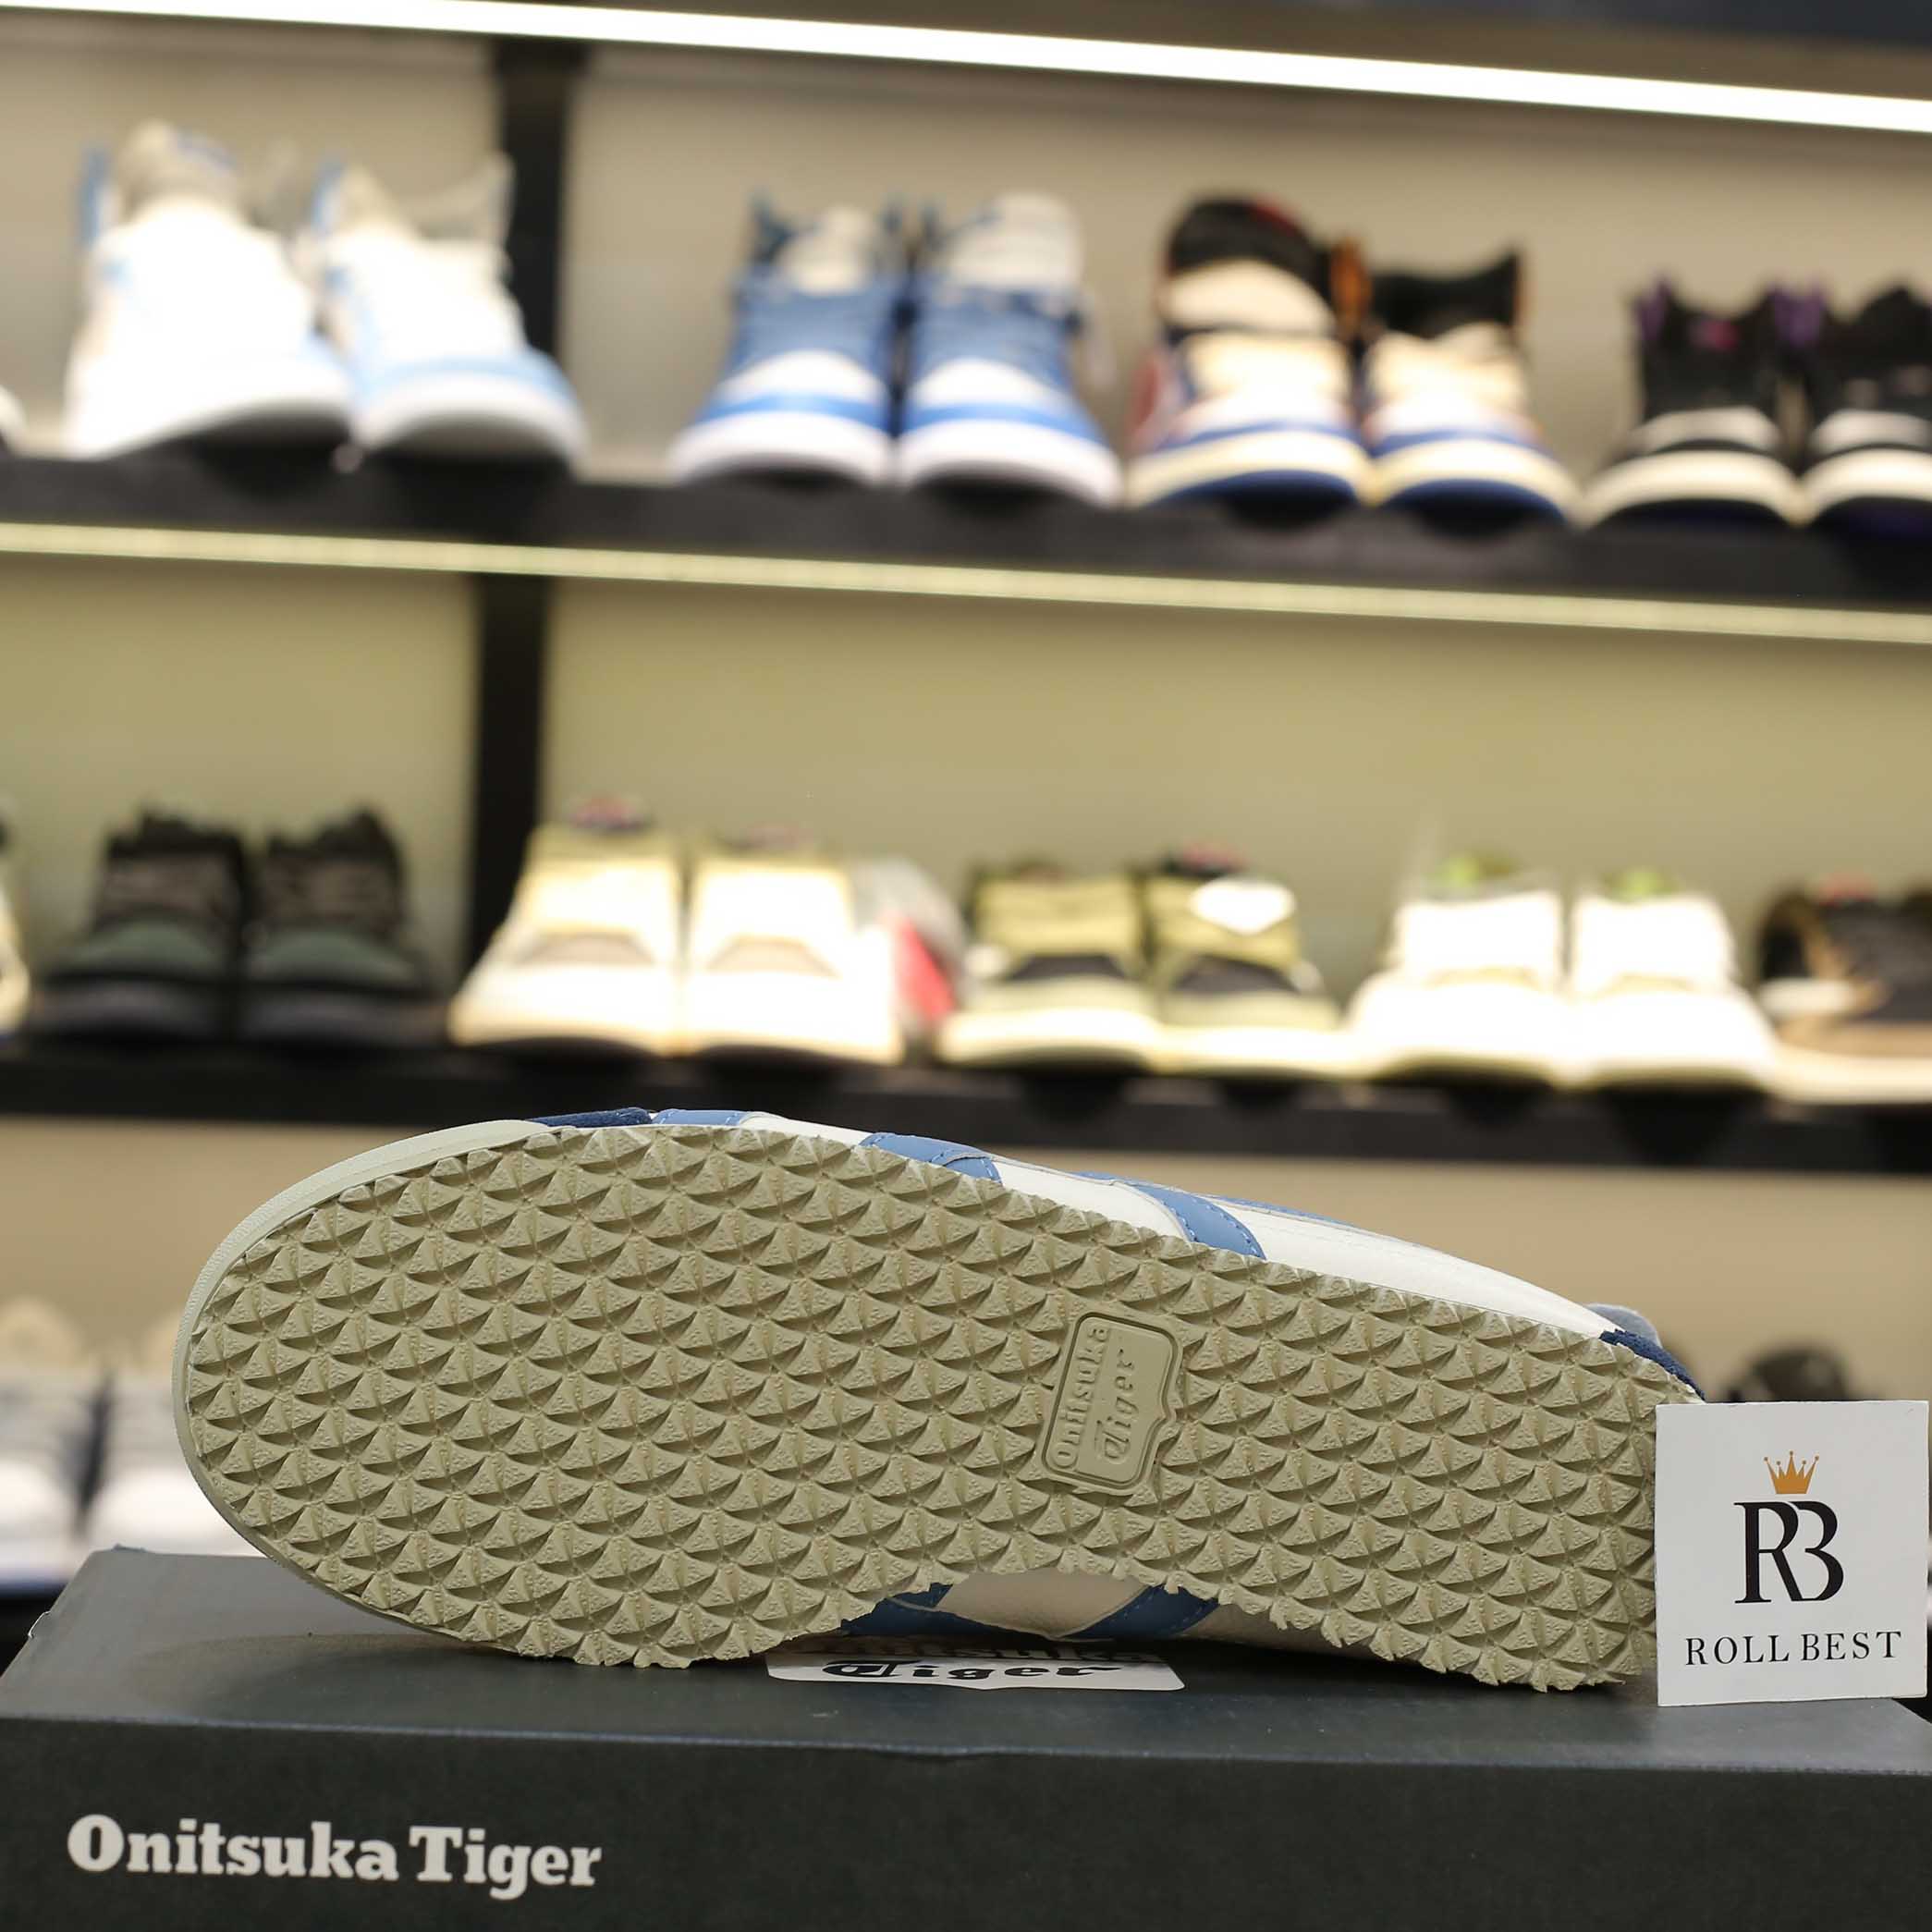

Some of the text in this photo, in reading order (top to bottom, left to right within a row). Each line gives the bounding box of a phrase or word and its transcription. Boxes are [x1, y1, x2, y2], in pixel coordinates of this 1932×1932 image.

[1051, 1328, 1110, 1469] Onitsuka
[1733, 1500, 1844, 1604] RB
[822, 1659, 1122, 1681] Tiger
[1685, 1631, 1901, 1666] ROLL BEST
[67, 1814, 602, 1901] Onitsuka Tiger
